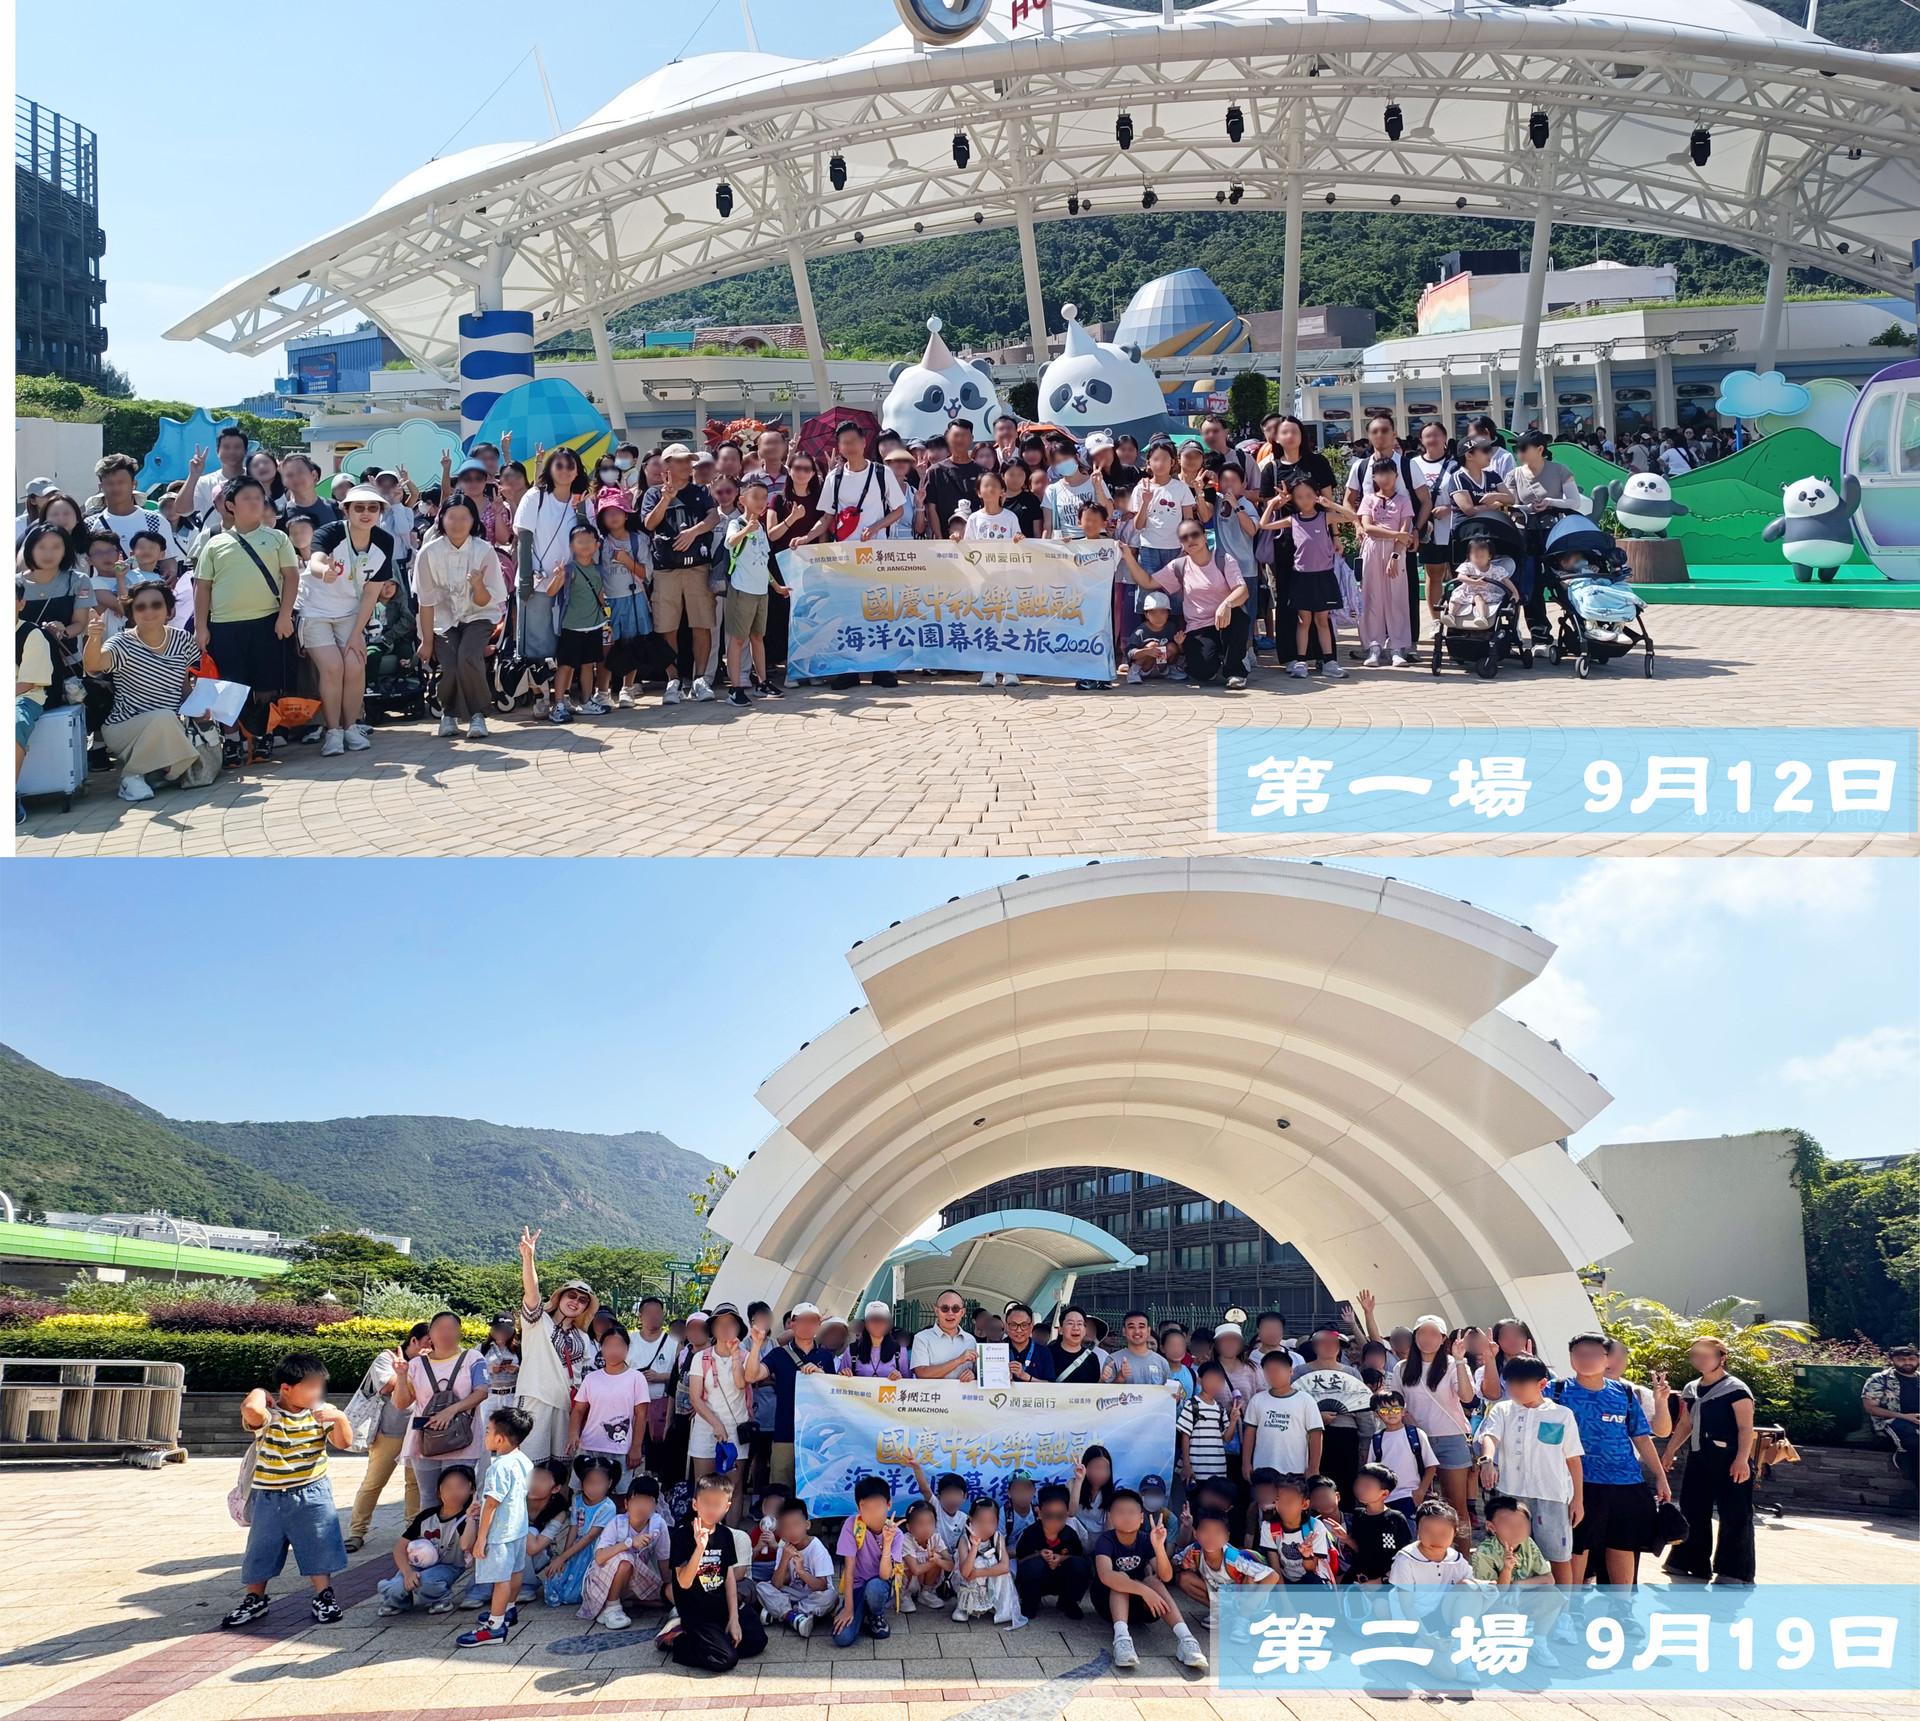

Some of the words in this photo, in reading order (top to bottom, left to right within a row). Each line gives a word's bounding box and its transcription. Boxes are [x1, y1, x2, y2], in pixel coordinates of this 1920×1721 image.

[861, 585, 1085, 625] 國慶中秋樂融融
[907, 1406, 949, 1415] JIANGZHONG
